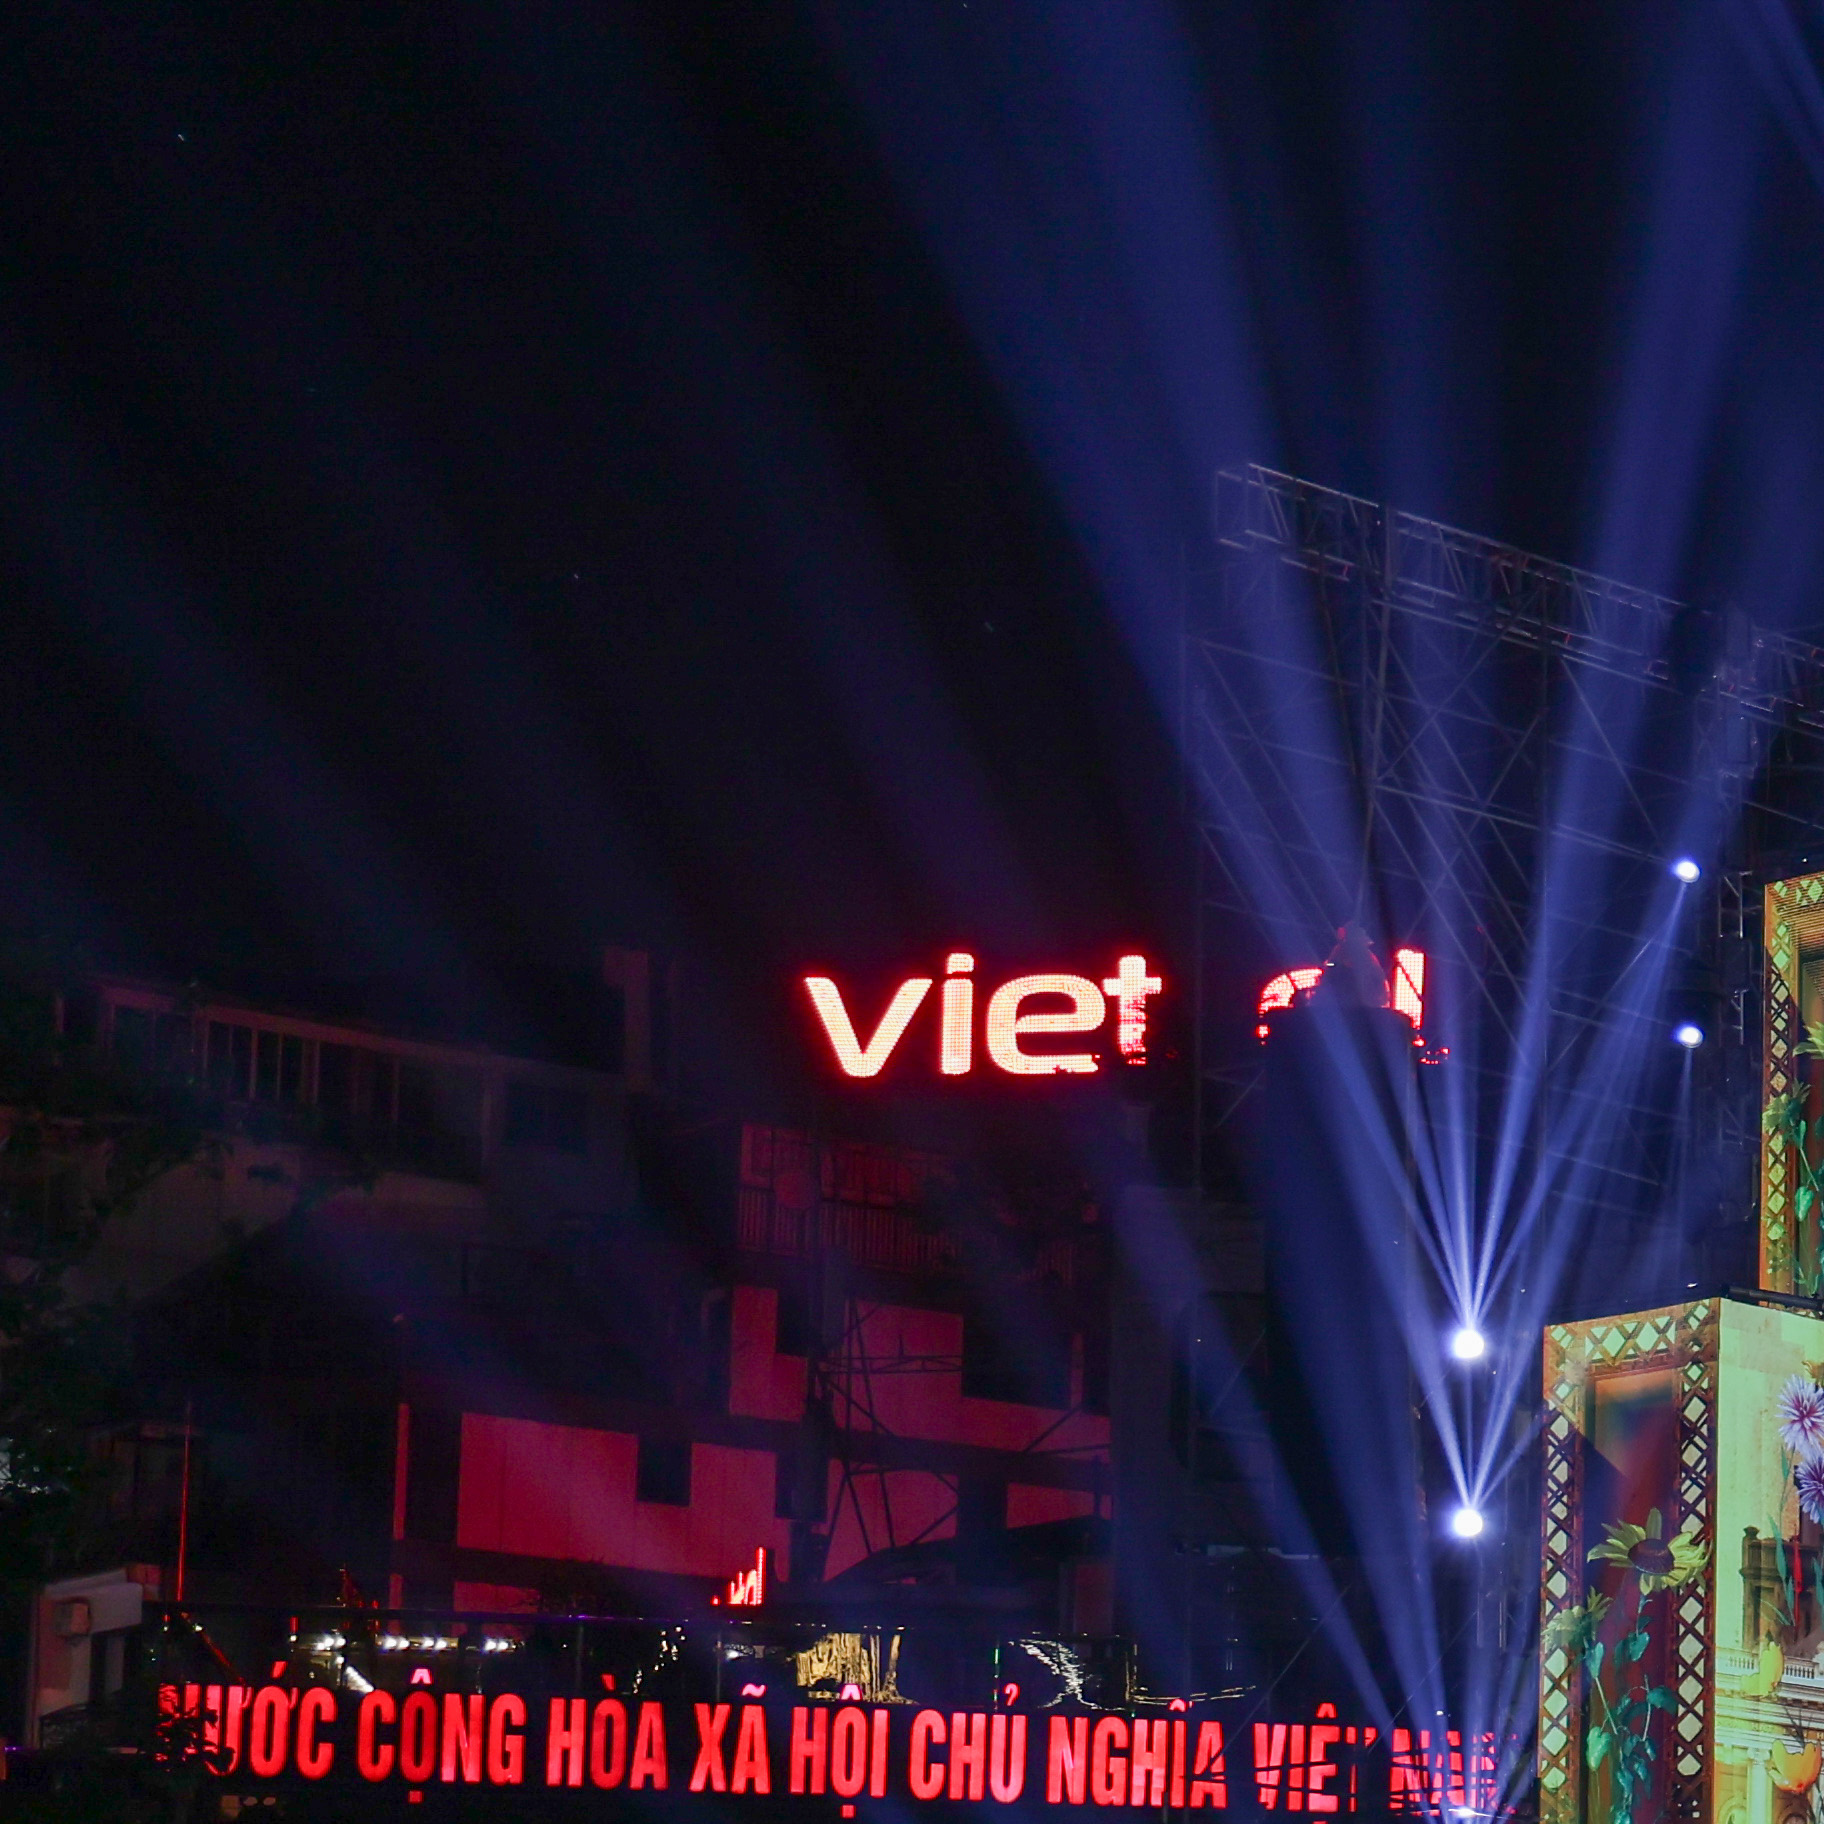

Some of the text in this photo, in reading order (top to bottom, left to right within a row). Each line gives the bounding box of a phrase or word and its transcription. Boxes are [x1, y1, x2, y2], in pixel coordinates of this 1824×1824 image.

[357, 1668, 527, 1803] CỘNG
[547, 1674, 668, 1791] HÒA
[690, 1682, 771, 1794] XÃ
[789, 1683, 889, 1818] HỘI
[908, 1682, 1027, 1804] CHỦ
[1046, 1698, 1228, 1810] NGHĨA
